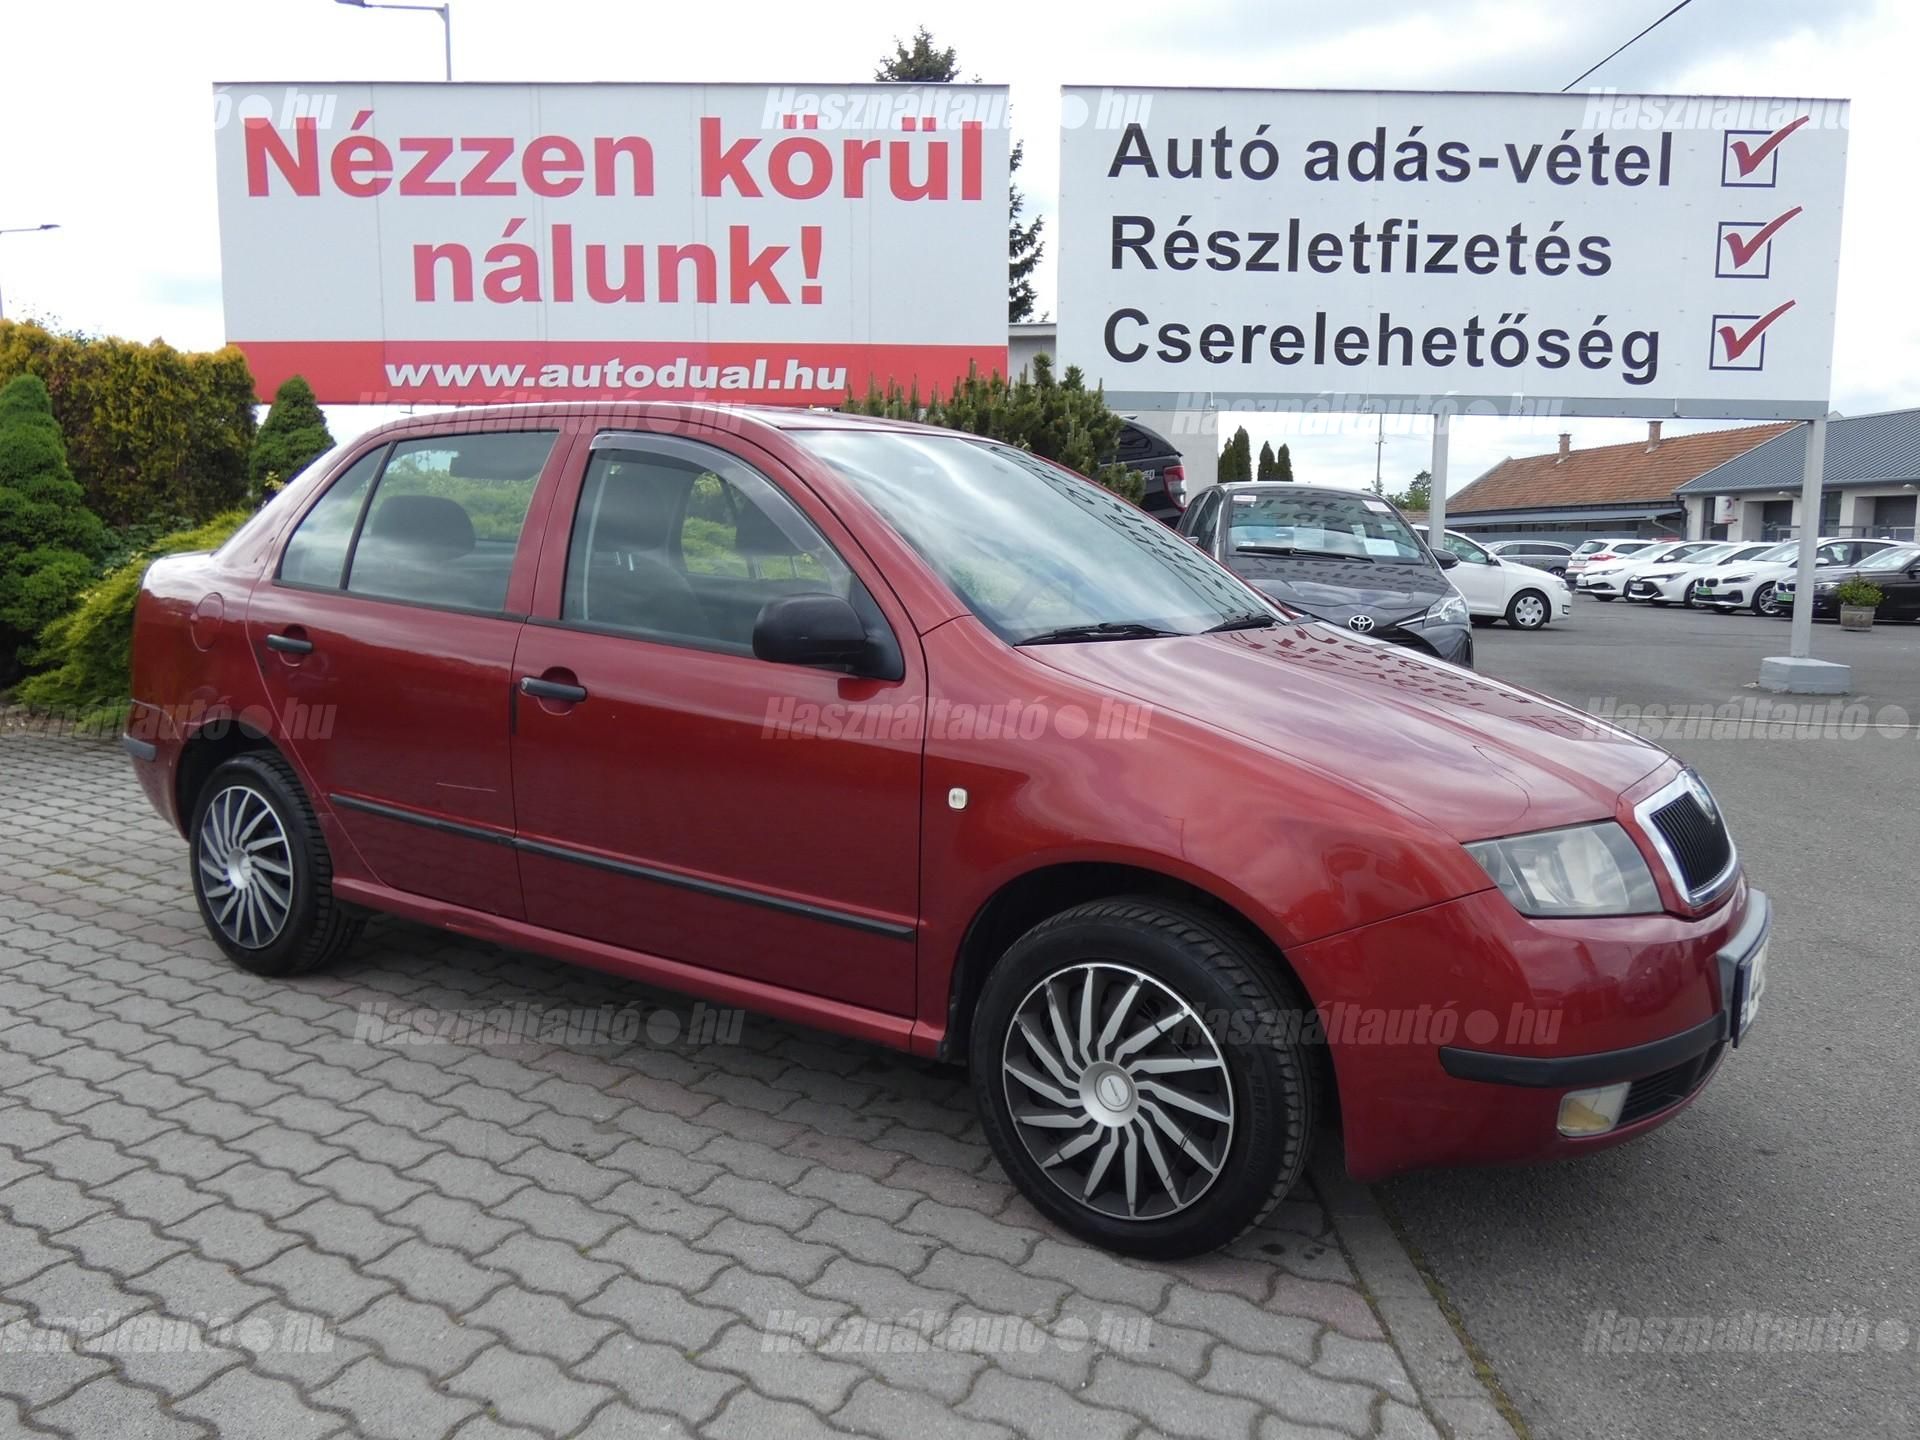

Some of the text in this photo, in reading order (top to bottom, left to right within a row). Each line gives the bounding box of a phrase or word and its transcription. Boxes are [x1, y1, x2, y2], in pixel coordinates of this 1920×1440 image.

[246, 110, 982, 201] Nézzen körül
[1107, 122, 1672, 187] Autó adás-vétel
[413, 218, 822, 305] nálunk!
[1111, 215, 1613, 278] Részletfizetés
[385, 357, 848, 391] www.autodual.hu
[1104, 308, 1660, 386] Cserelehetőség
